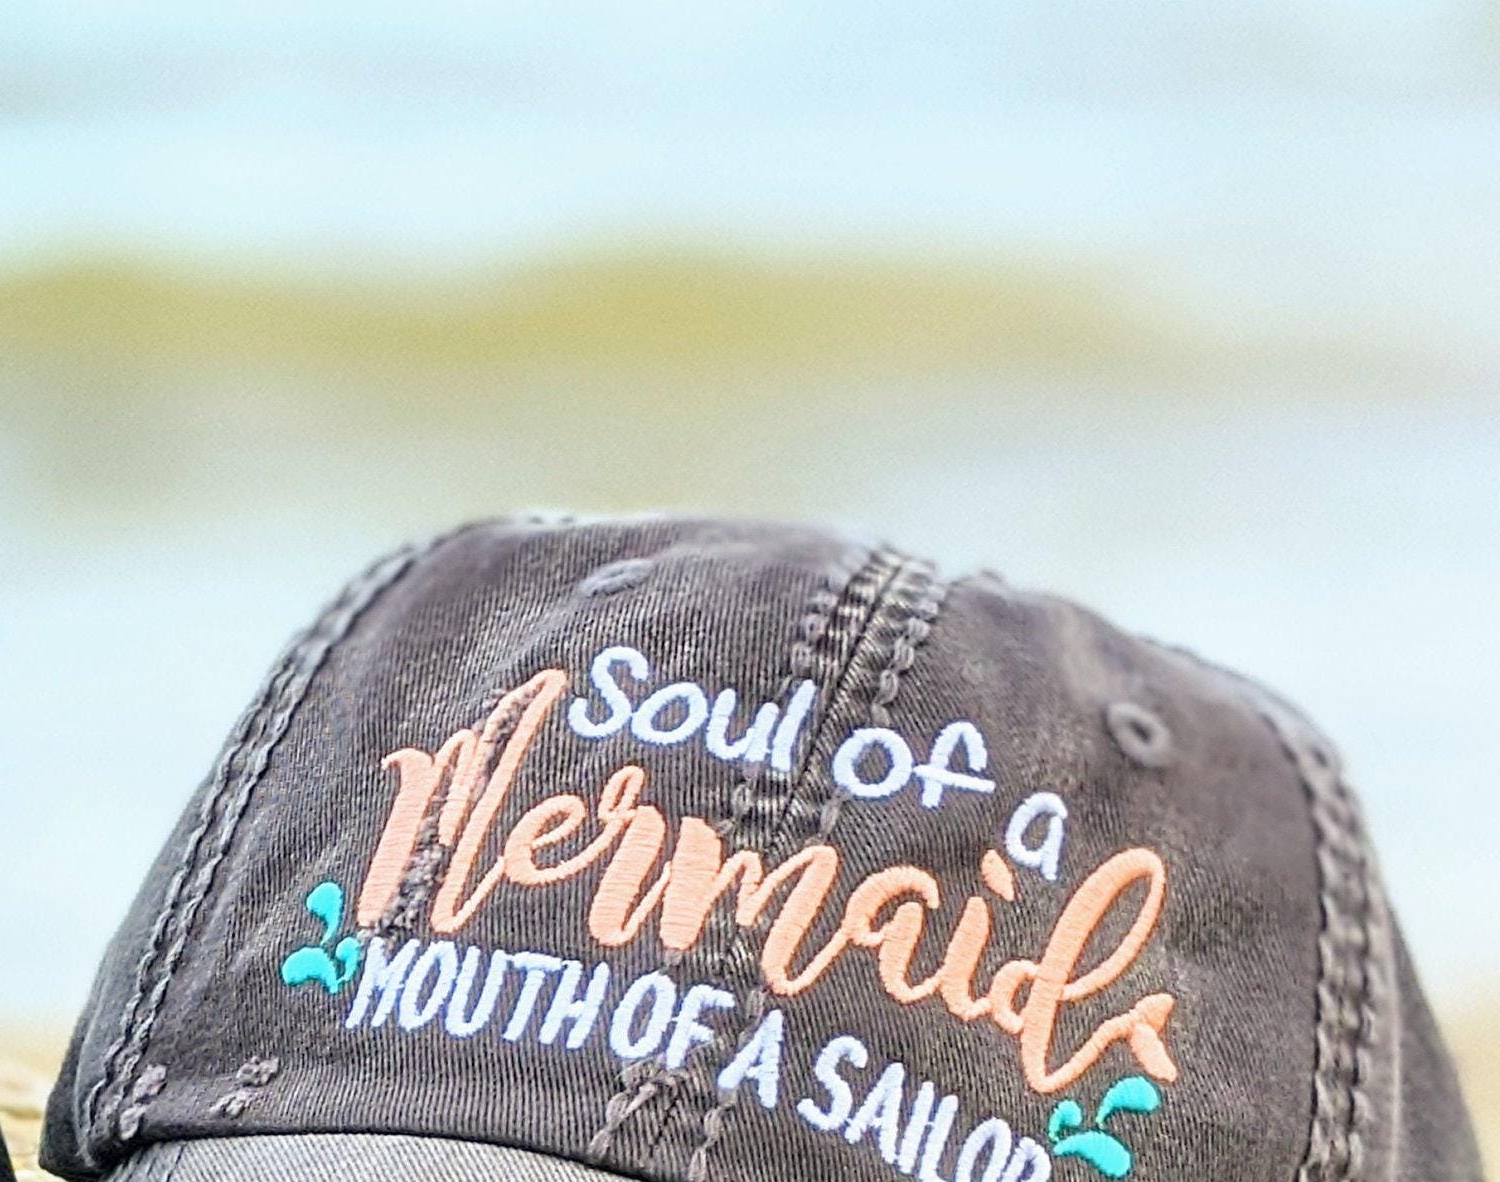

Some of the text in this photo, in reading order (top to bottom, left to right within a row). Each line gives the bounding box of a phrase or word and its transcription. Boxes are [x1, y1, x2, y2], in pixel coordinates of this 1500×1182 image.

[567, 646, 1068, 880] Soul of a
[357, 669, 1177, 1094] Mermaid
[345, 936, 610, 1049] MOUTH
[609, 972, 736, 1070] OF
[717, 1010, 783, 1109] A
